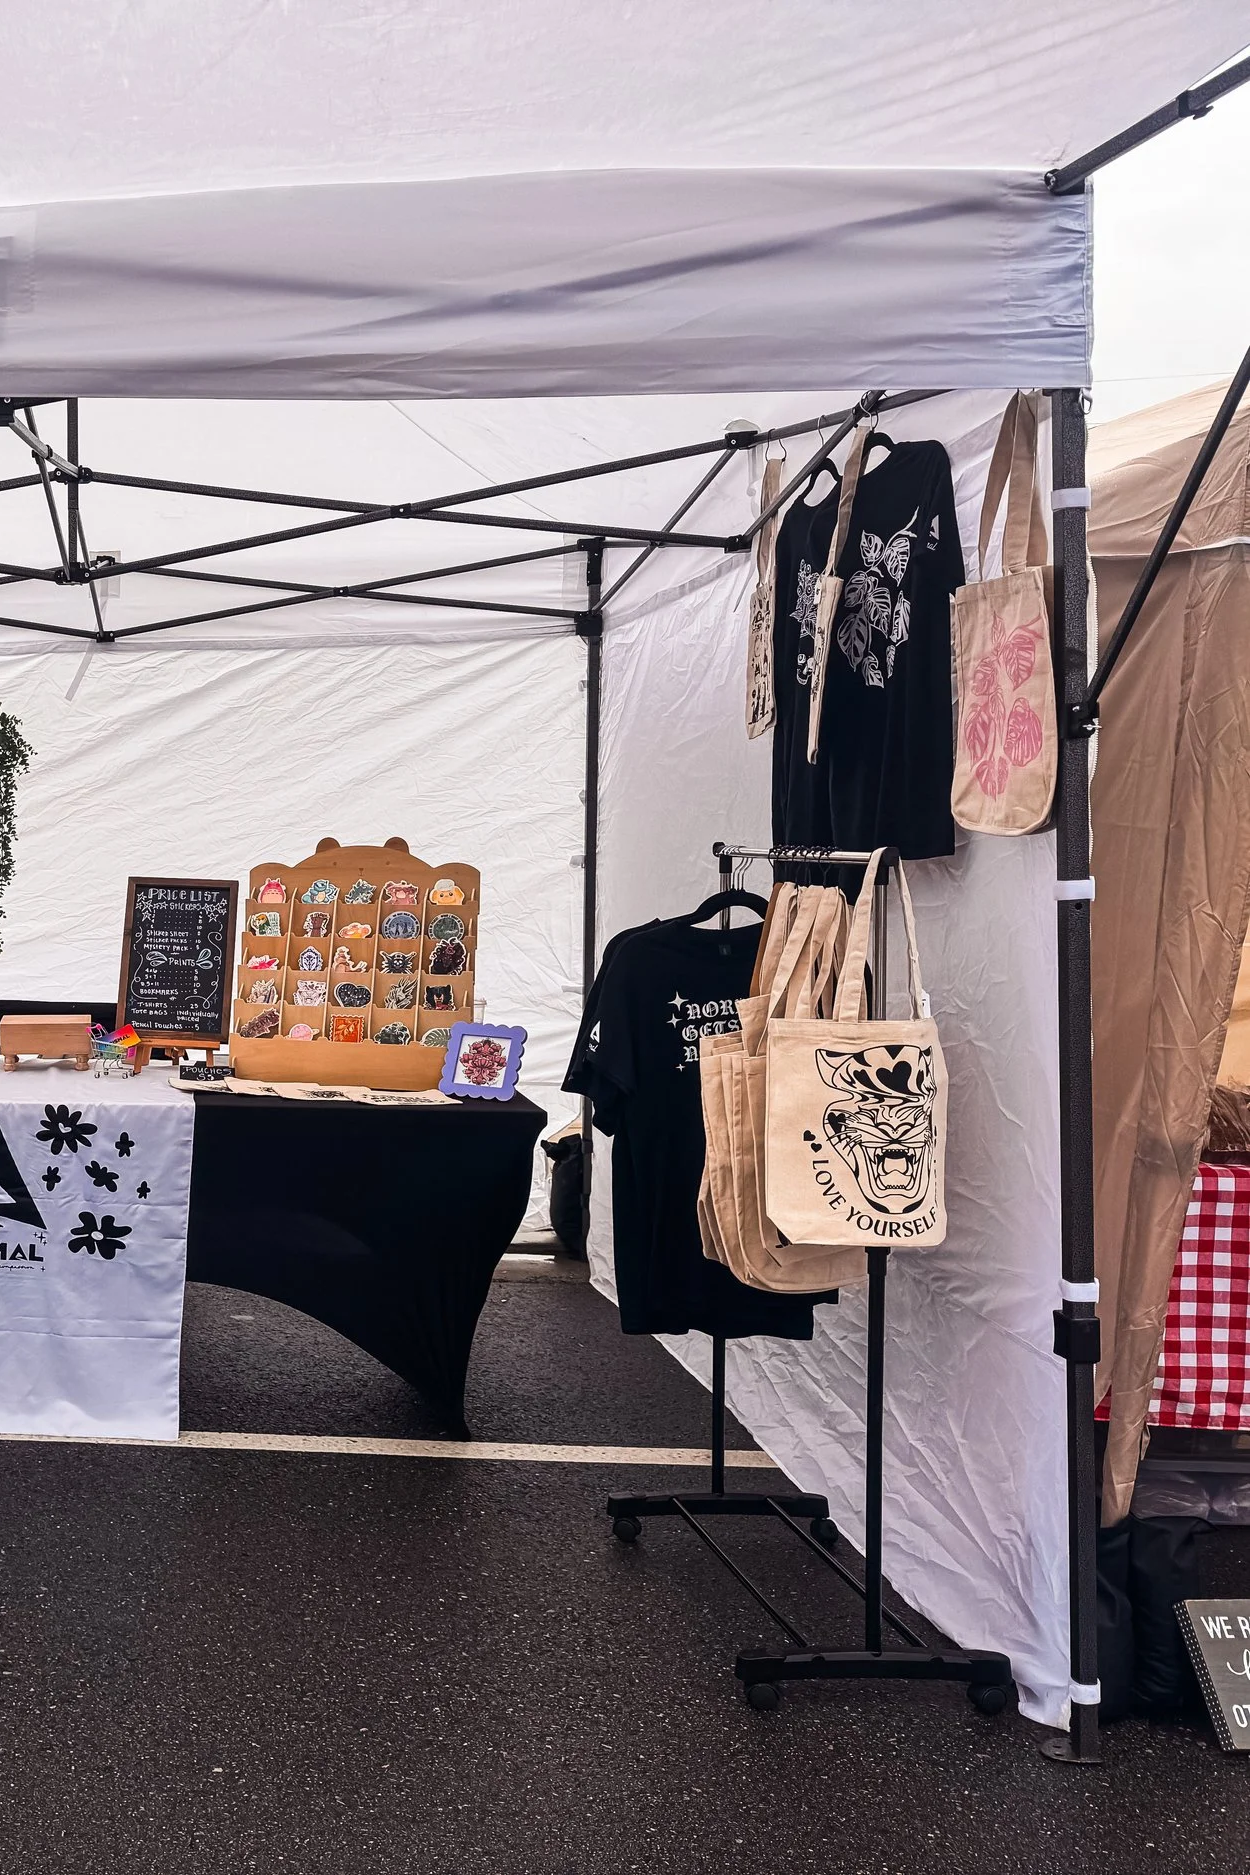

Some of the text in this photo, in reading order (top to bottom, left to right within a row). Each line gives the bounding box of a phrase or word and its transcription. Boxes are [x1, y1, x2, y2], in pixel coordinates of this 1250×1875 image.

[148, 888, 220, 902] PRICE LIST
[168, 957, 196, 967] PRINTS
[139, 988, 179, 996] BOOKMARKS
[812, 1159, 937, 1238] LOVE YOURSELF
[1200, 1615, 1236, 1639] WE
